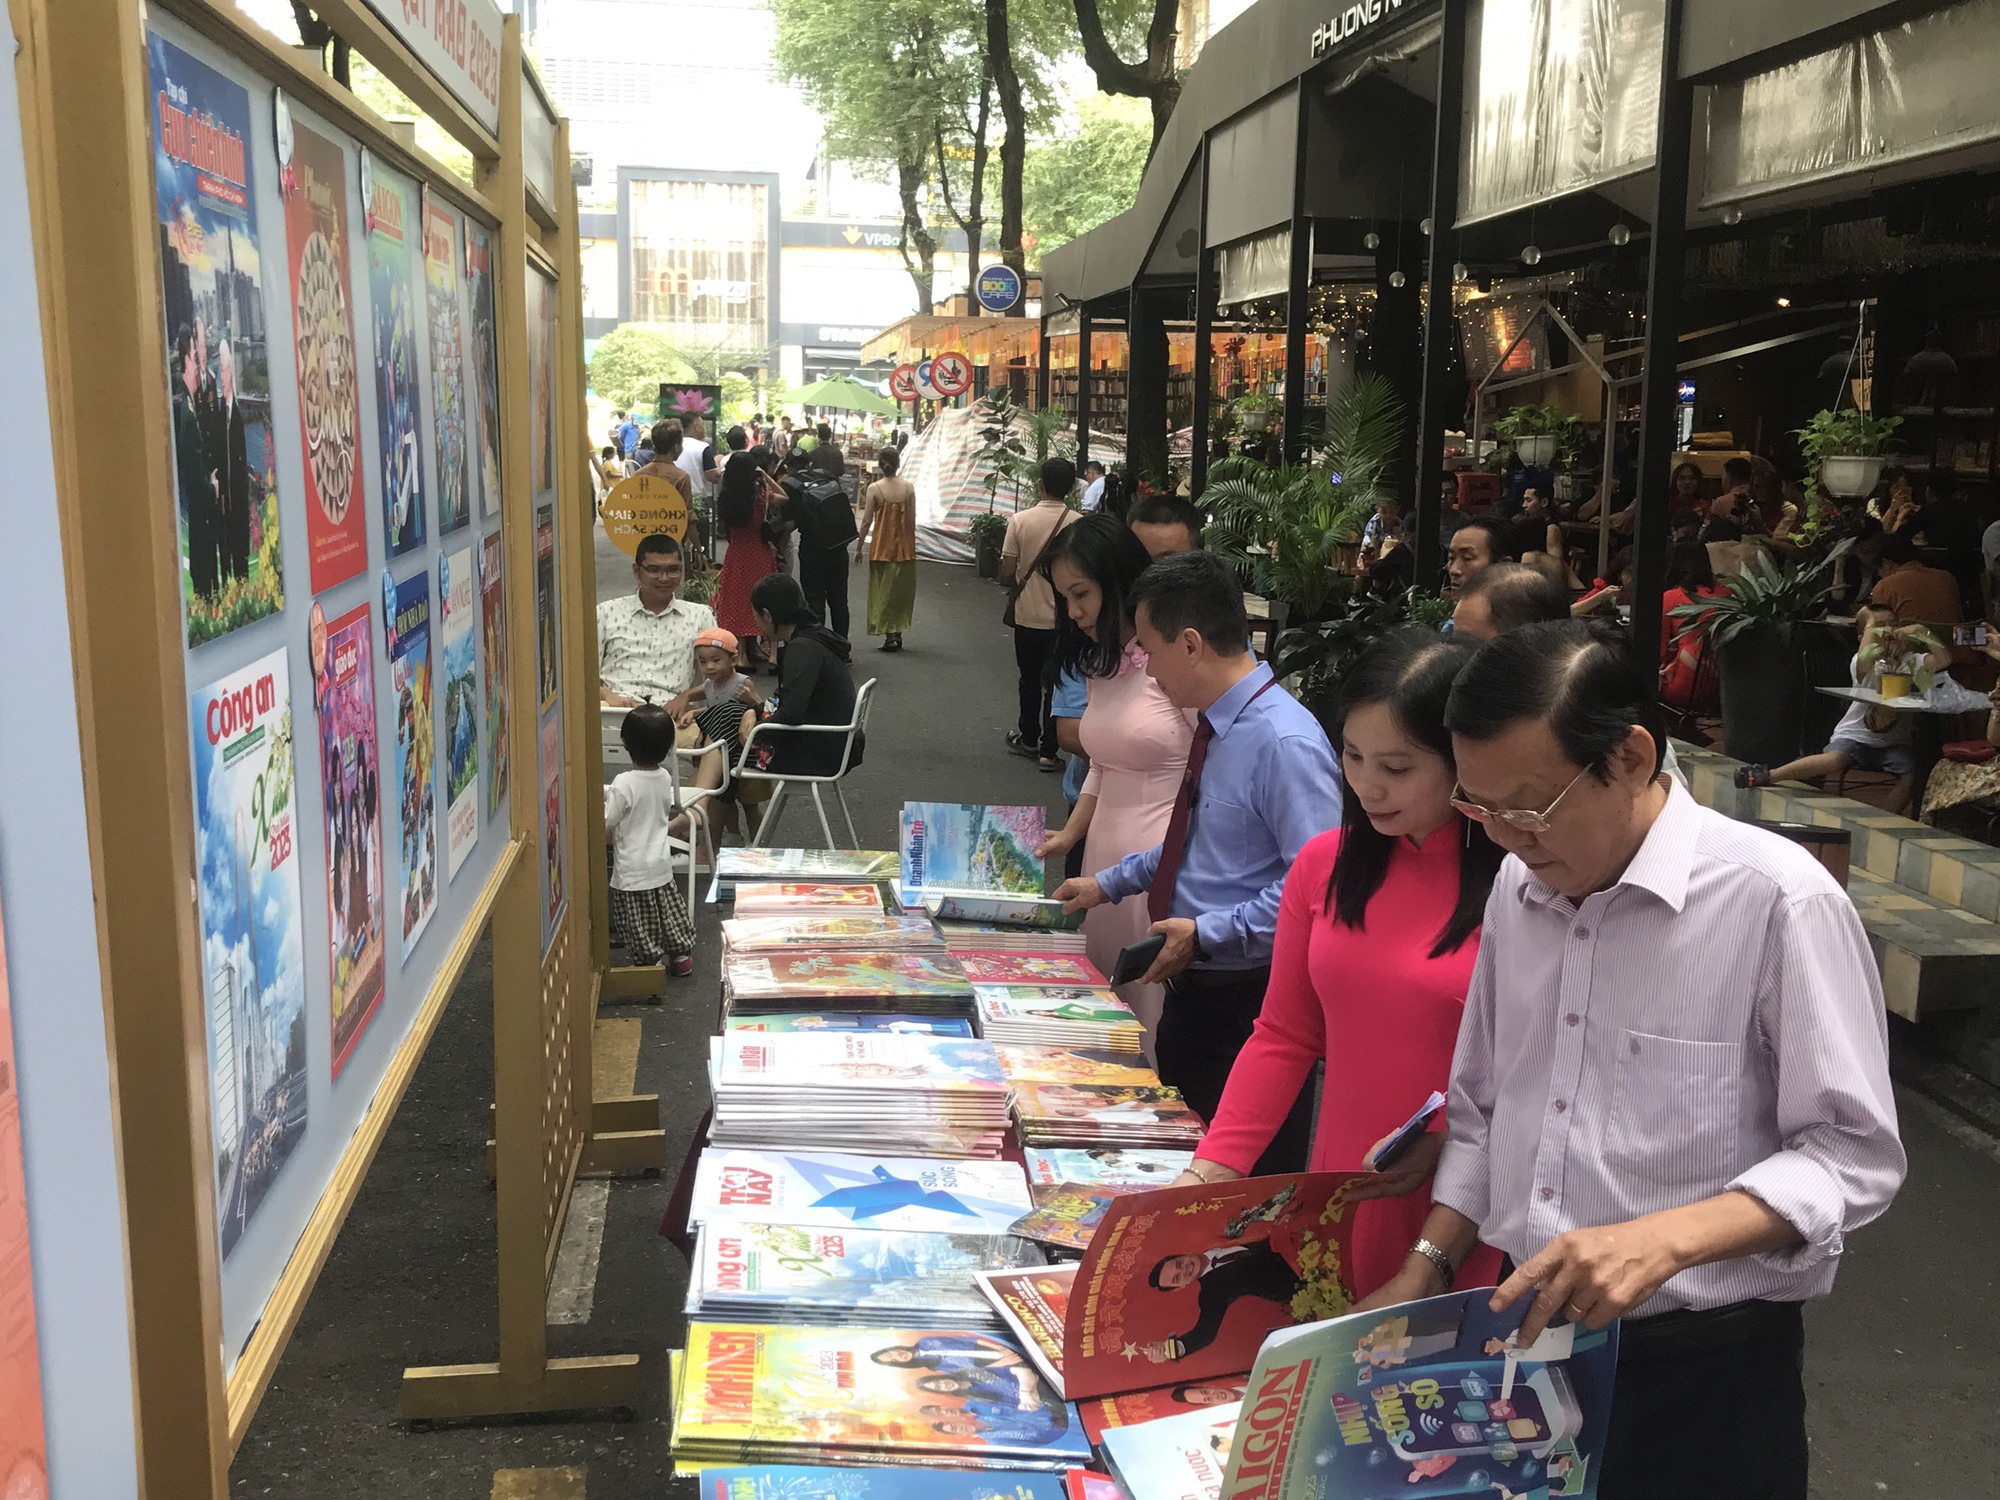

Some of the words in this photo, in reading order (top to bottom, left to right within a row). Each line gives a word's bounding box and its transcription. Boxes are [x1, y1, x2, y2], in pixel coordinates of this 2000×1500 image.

[469, 19, 498, 107] 2023
[864, 232, 915, 247] VPBak
[982, 281, 1015, 291] BOOK
[982, 290, 1015, 300] CAFE
[206, 683, 254, 746] Công
[255, 672, 275, 716] an
[270, 824, 292, 872] 2023
[746, 1168, 772, 1205] NAY
[822, 1234, 845, 1259] 2023
[1095, 1247, 1115, 1275] PHÓNG
[1084, 1294, 1099, 1315] GÒN
[1081, 1315, 1096, 1334] SÀI
[1080, 1335, 1095, 1358] BÁO
[1331, 1392, 1373, 1446] NHỊP
